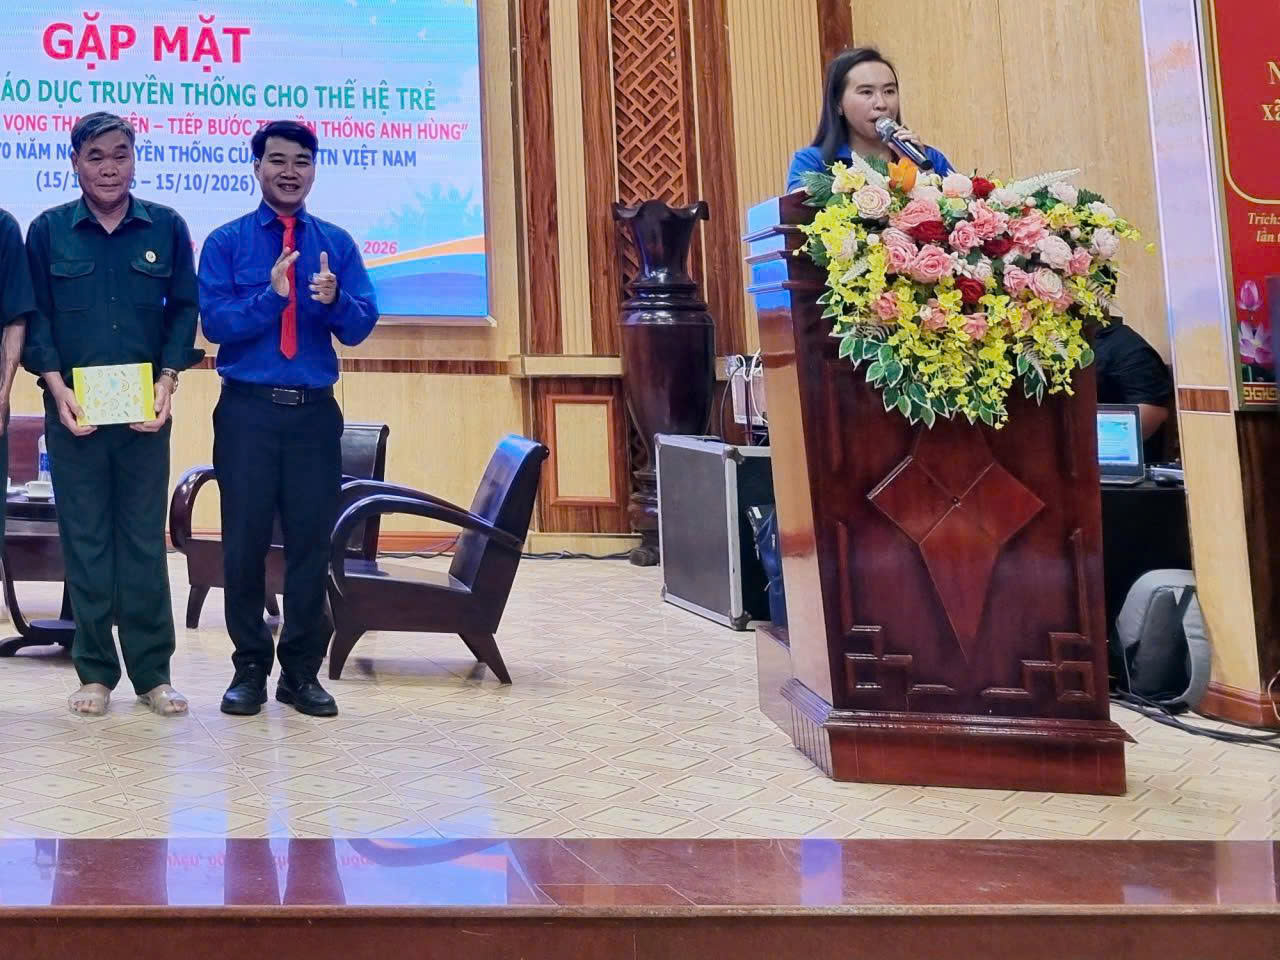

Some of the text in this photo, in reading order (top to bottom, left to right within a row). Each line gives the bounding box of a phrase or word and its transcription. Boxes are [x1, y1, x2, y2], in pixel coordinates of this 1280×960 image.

[42, 11, 251, 73] GẶP MẶT
[38, 80, 82, 108] DỤC
[88, 74, 174, 105] TRUYỀN
[180, 76, 256, 107] THỐNG
[263, 84, 308, 108] CHO
[314, 78, 357, 109] THẾ
[363, 79, 390, 116] HỆ
[396, 80, 437, 111] TRẺ
[3, 114, 48, 136] VỌNG
[167, 112, 203, 135] TIẾP
[207, 114, 252, 136] BƯỚC
[320, 115, 376, 139] THỐNG
[380, 122, 413, 139] ANH
[16, 137, 51, 160] NĂM
[169, 140, 224, 164] THỐNG
[342, 143, 378, 170] VIỆT
[383, 149, 417, 167] NAM
[155, 172, 256, 196] 15/10/2026)
[363, 240, 398, 255] 2026
